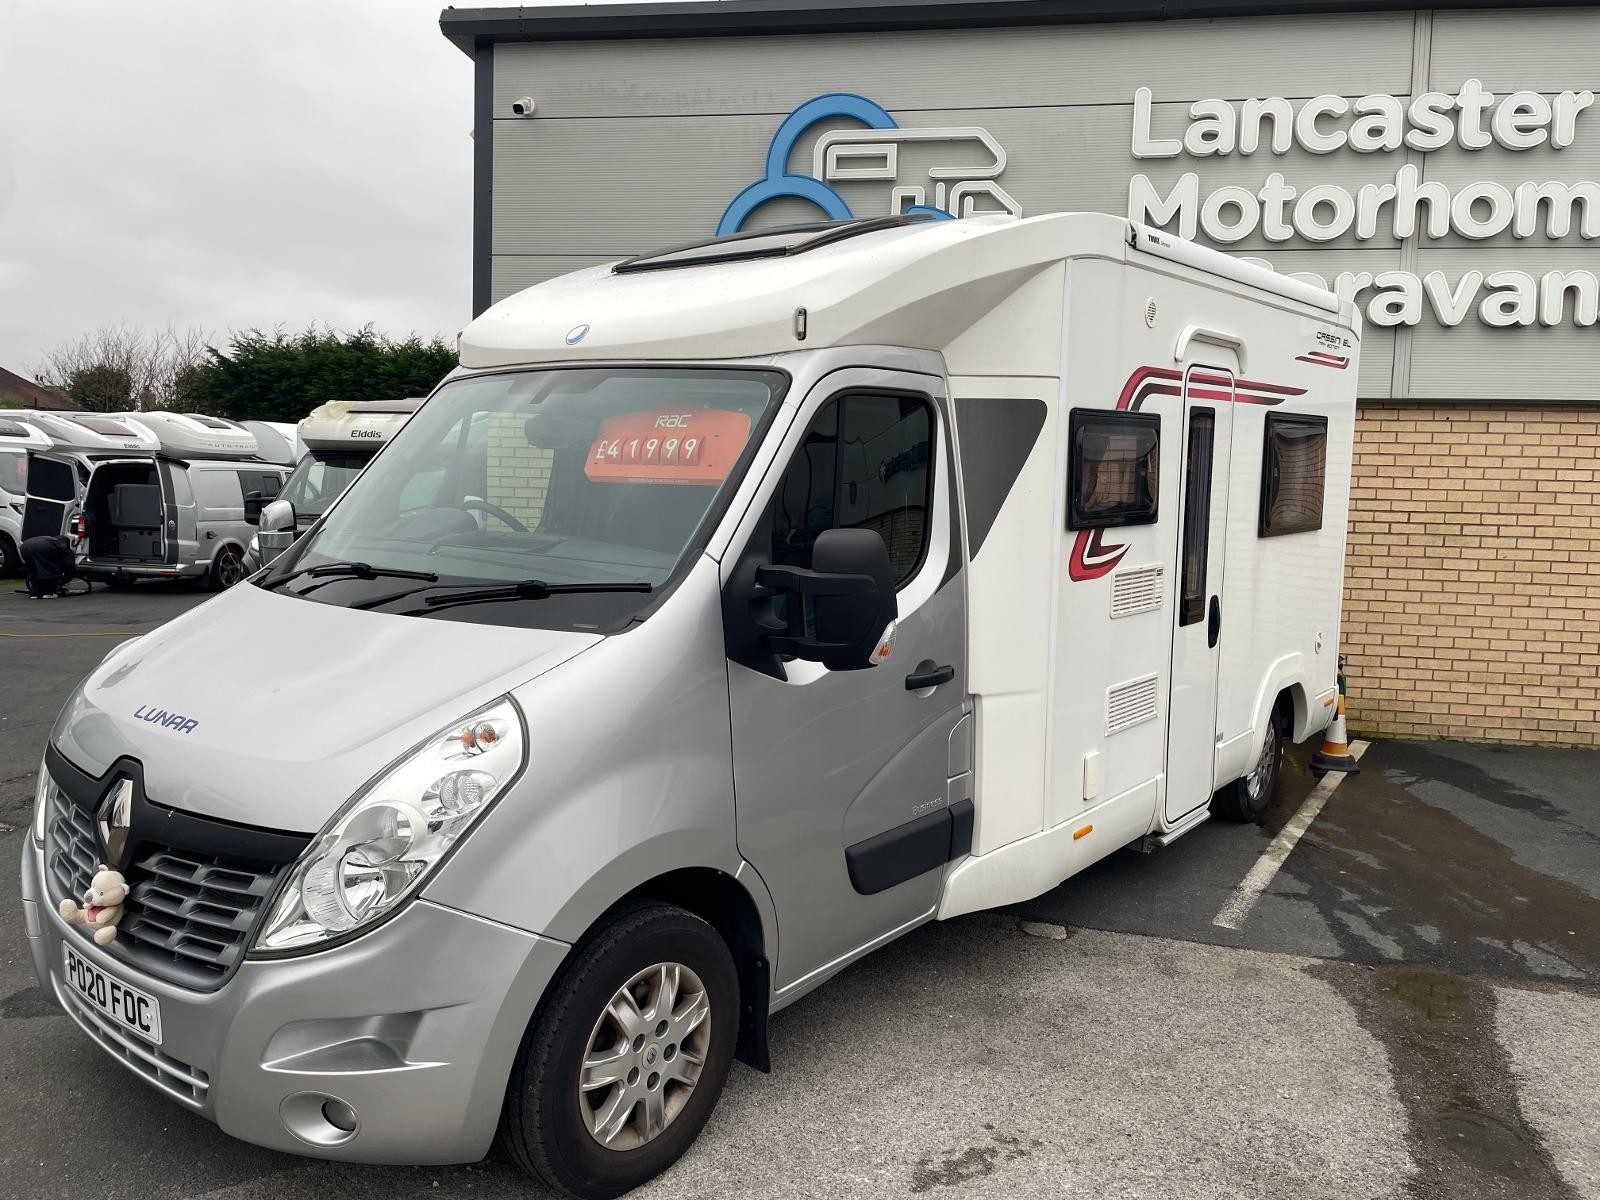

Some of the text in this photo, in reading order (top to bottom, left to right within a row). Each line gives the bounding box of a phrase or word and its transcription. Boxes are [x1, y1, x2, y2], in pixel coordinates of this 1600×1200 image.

[1130, 79, 1595, 159] Lancaster
[1239, 256, 1600, 328] ravan
[351, 429, 382, 439] Elddis
[596, 438, 697, 460] £41999
[134, 705, 199, 734] LUNAR
[68, 951, 151, 1032] PO20 FOC
